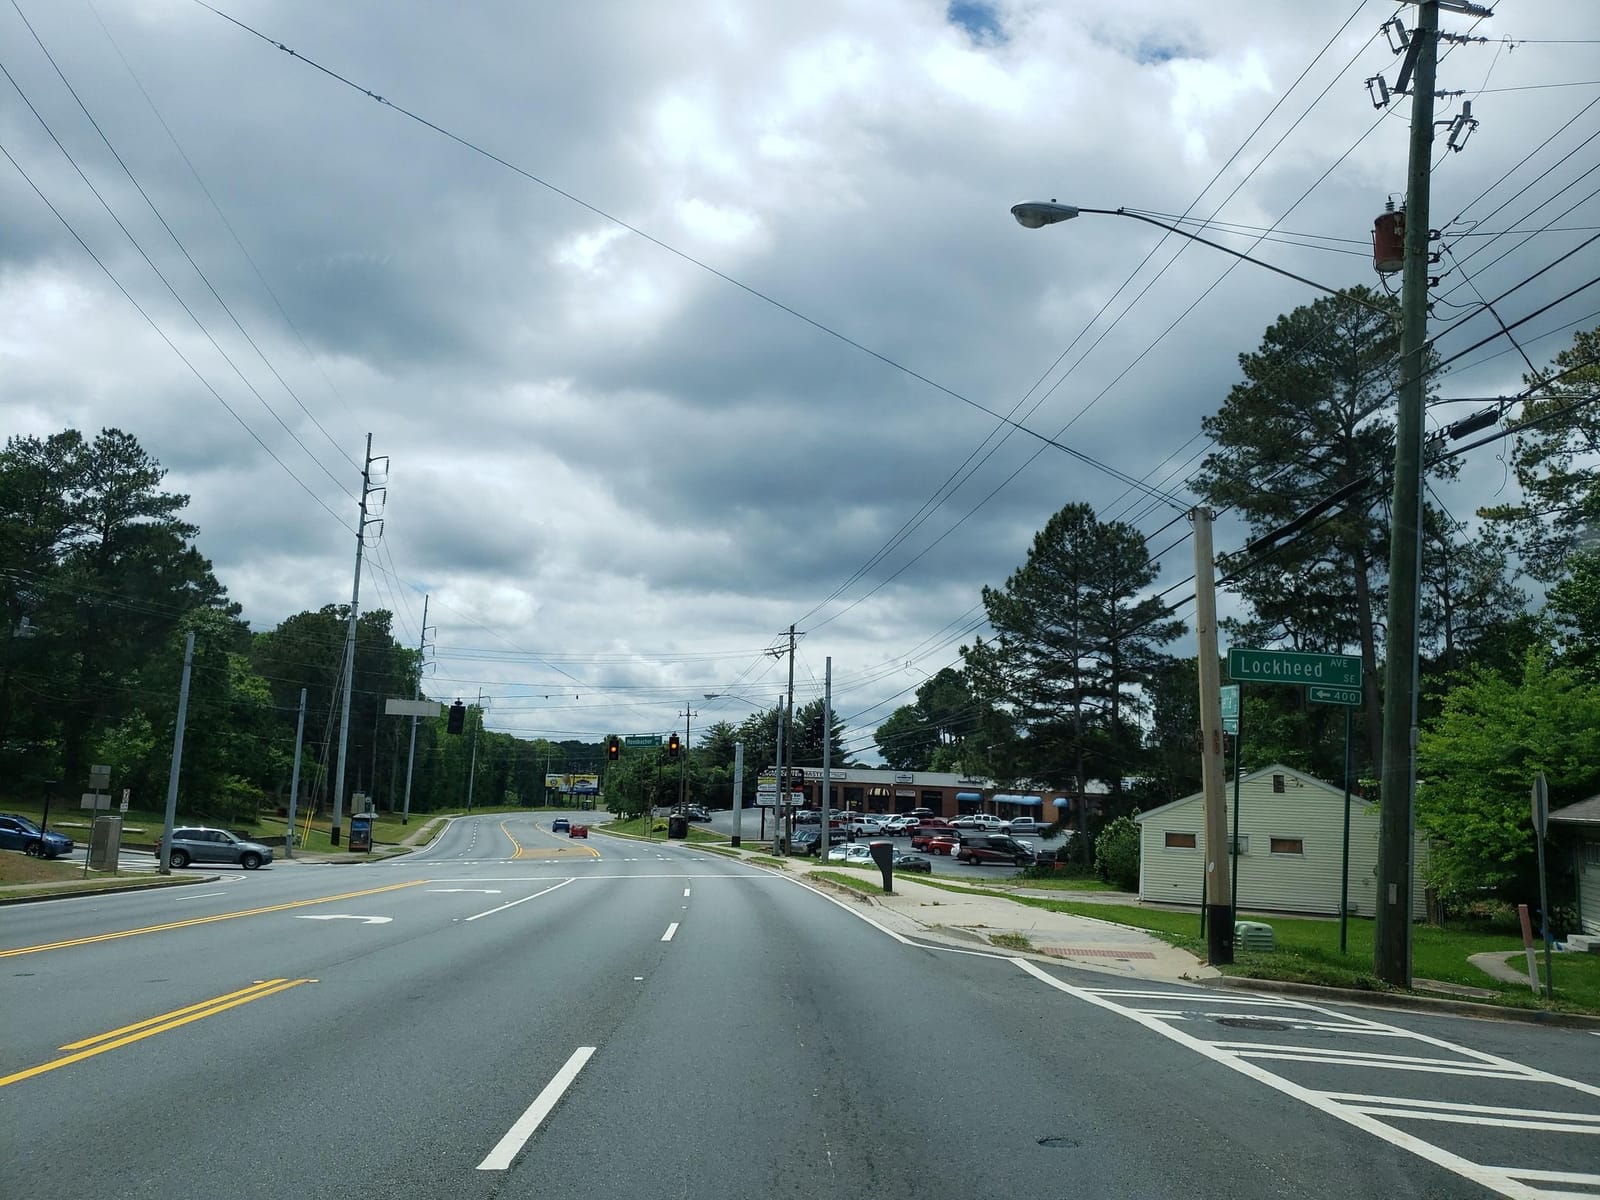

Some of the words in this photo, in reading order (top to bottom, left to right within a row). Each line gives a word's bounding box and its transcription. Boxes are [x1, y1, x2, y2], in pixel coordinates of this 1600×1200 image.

[1241, 656, 1322, 678] Lockheed
[1330, 658, 1348, 669] AVE
[1343, 674, 1356, 684] SE
[1334, 691, 1356, 702] 400
